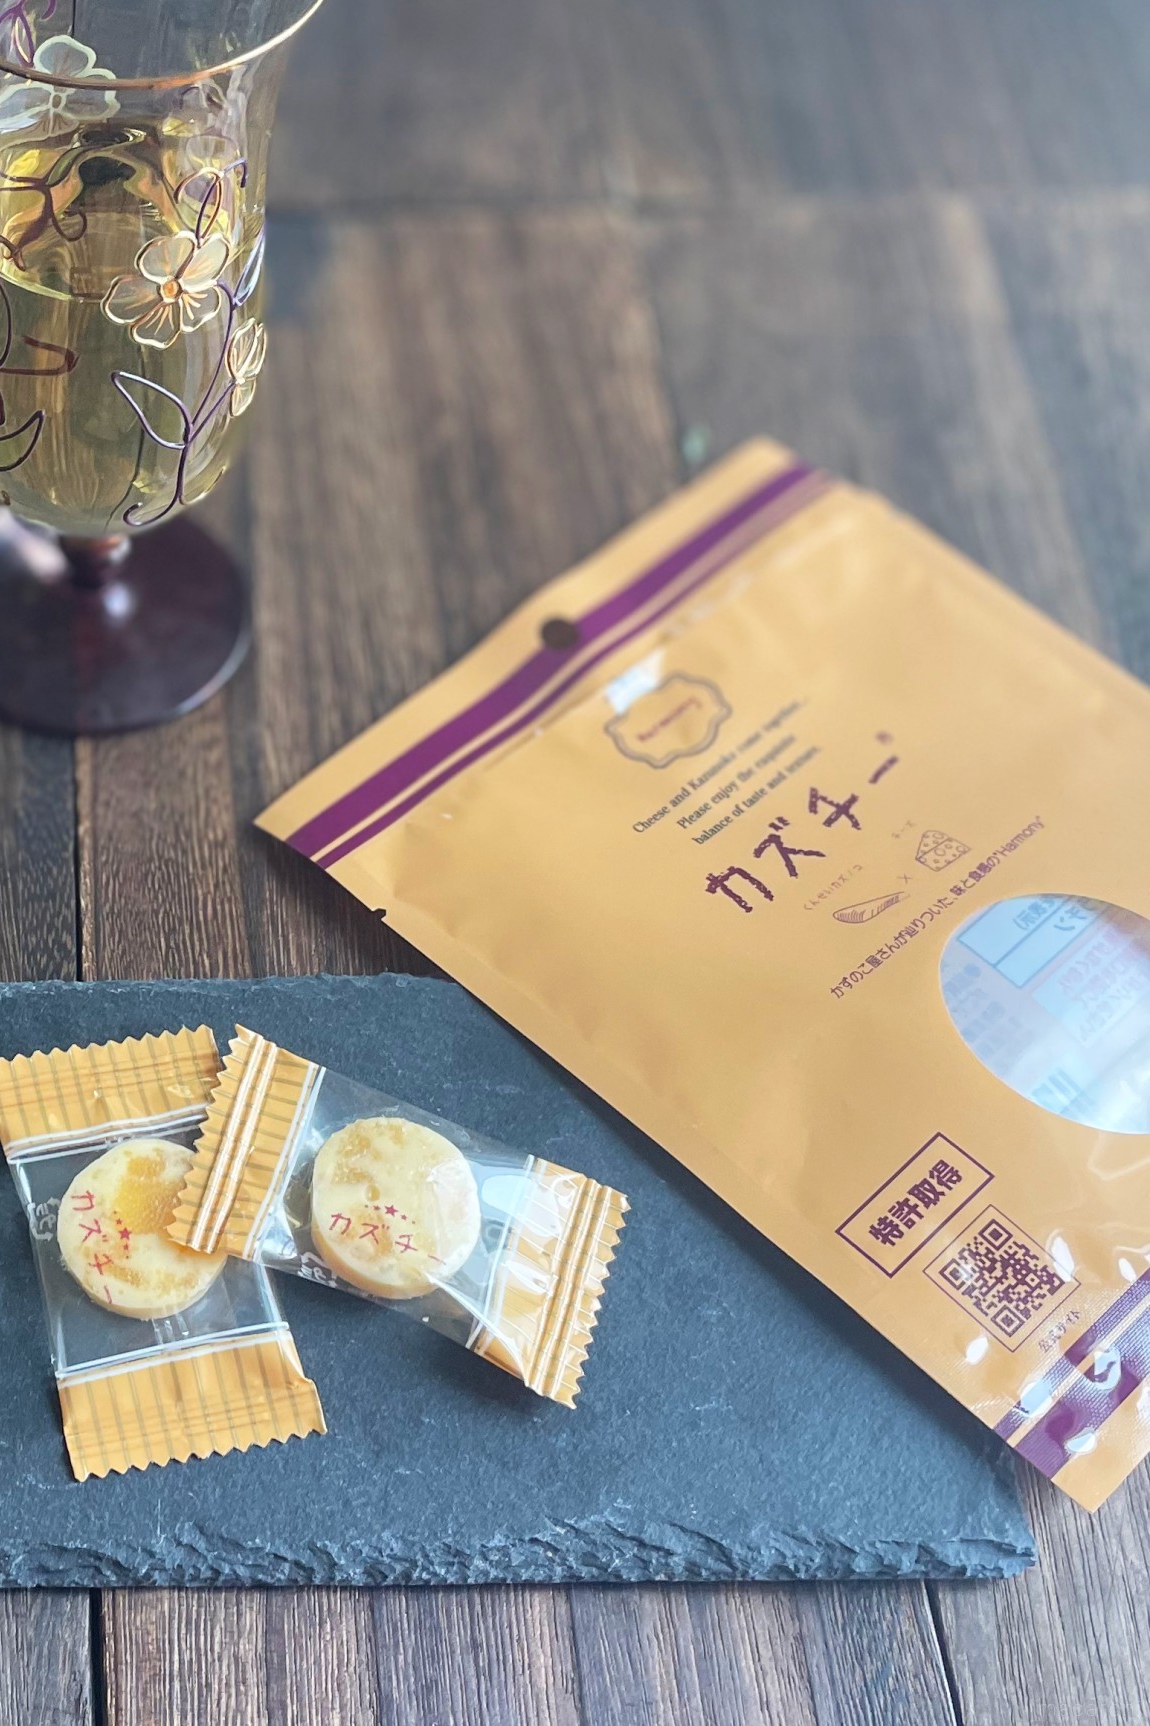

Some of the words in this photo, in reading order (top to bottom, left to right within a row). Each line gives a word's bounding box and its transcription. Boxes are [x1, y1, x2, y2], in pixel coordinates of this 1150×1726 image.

[631, 805, 671, 834] Cheese
[668, 786, 692, 808] and
[675, 802, 713, 830] Please
[710, 780, 740, 806] enjoy
[691, 815, 734, 845] balance
[730, 802, 746, 818] of
[741, 787, 768, 809] taste
[705, 755, 899, 912] カズチー
[868, 1159, 963, 1247] 特許取得
[71, 1190, 114, 1304] カズチー
[329, 1213, 447, 1266] カズチー
